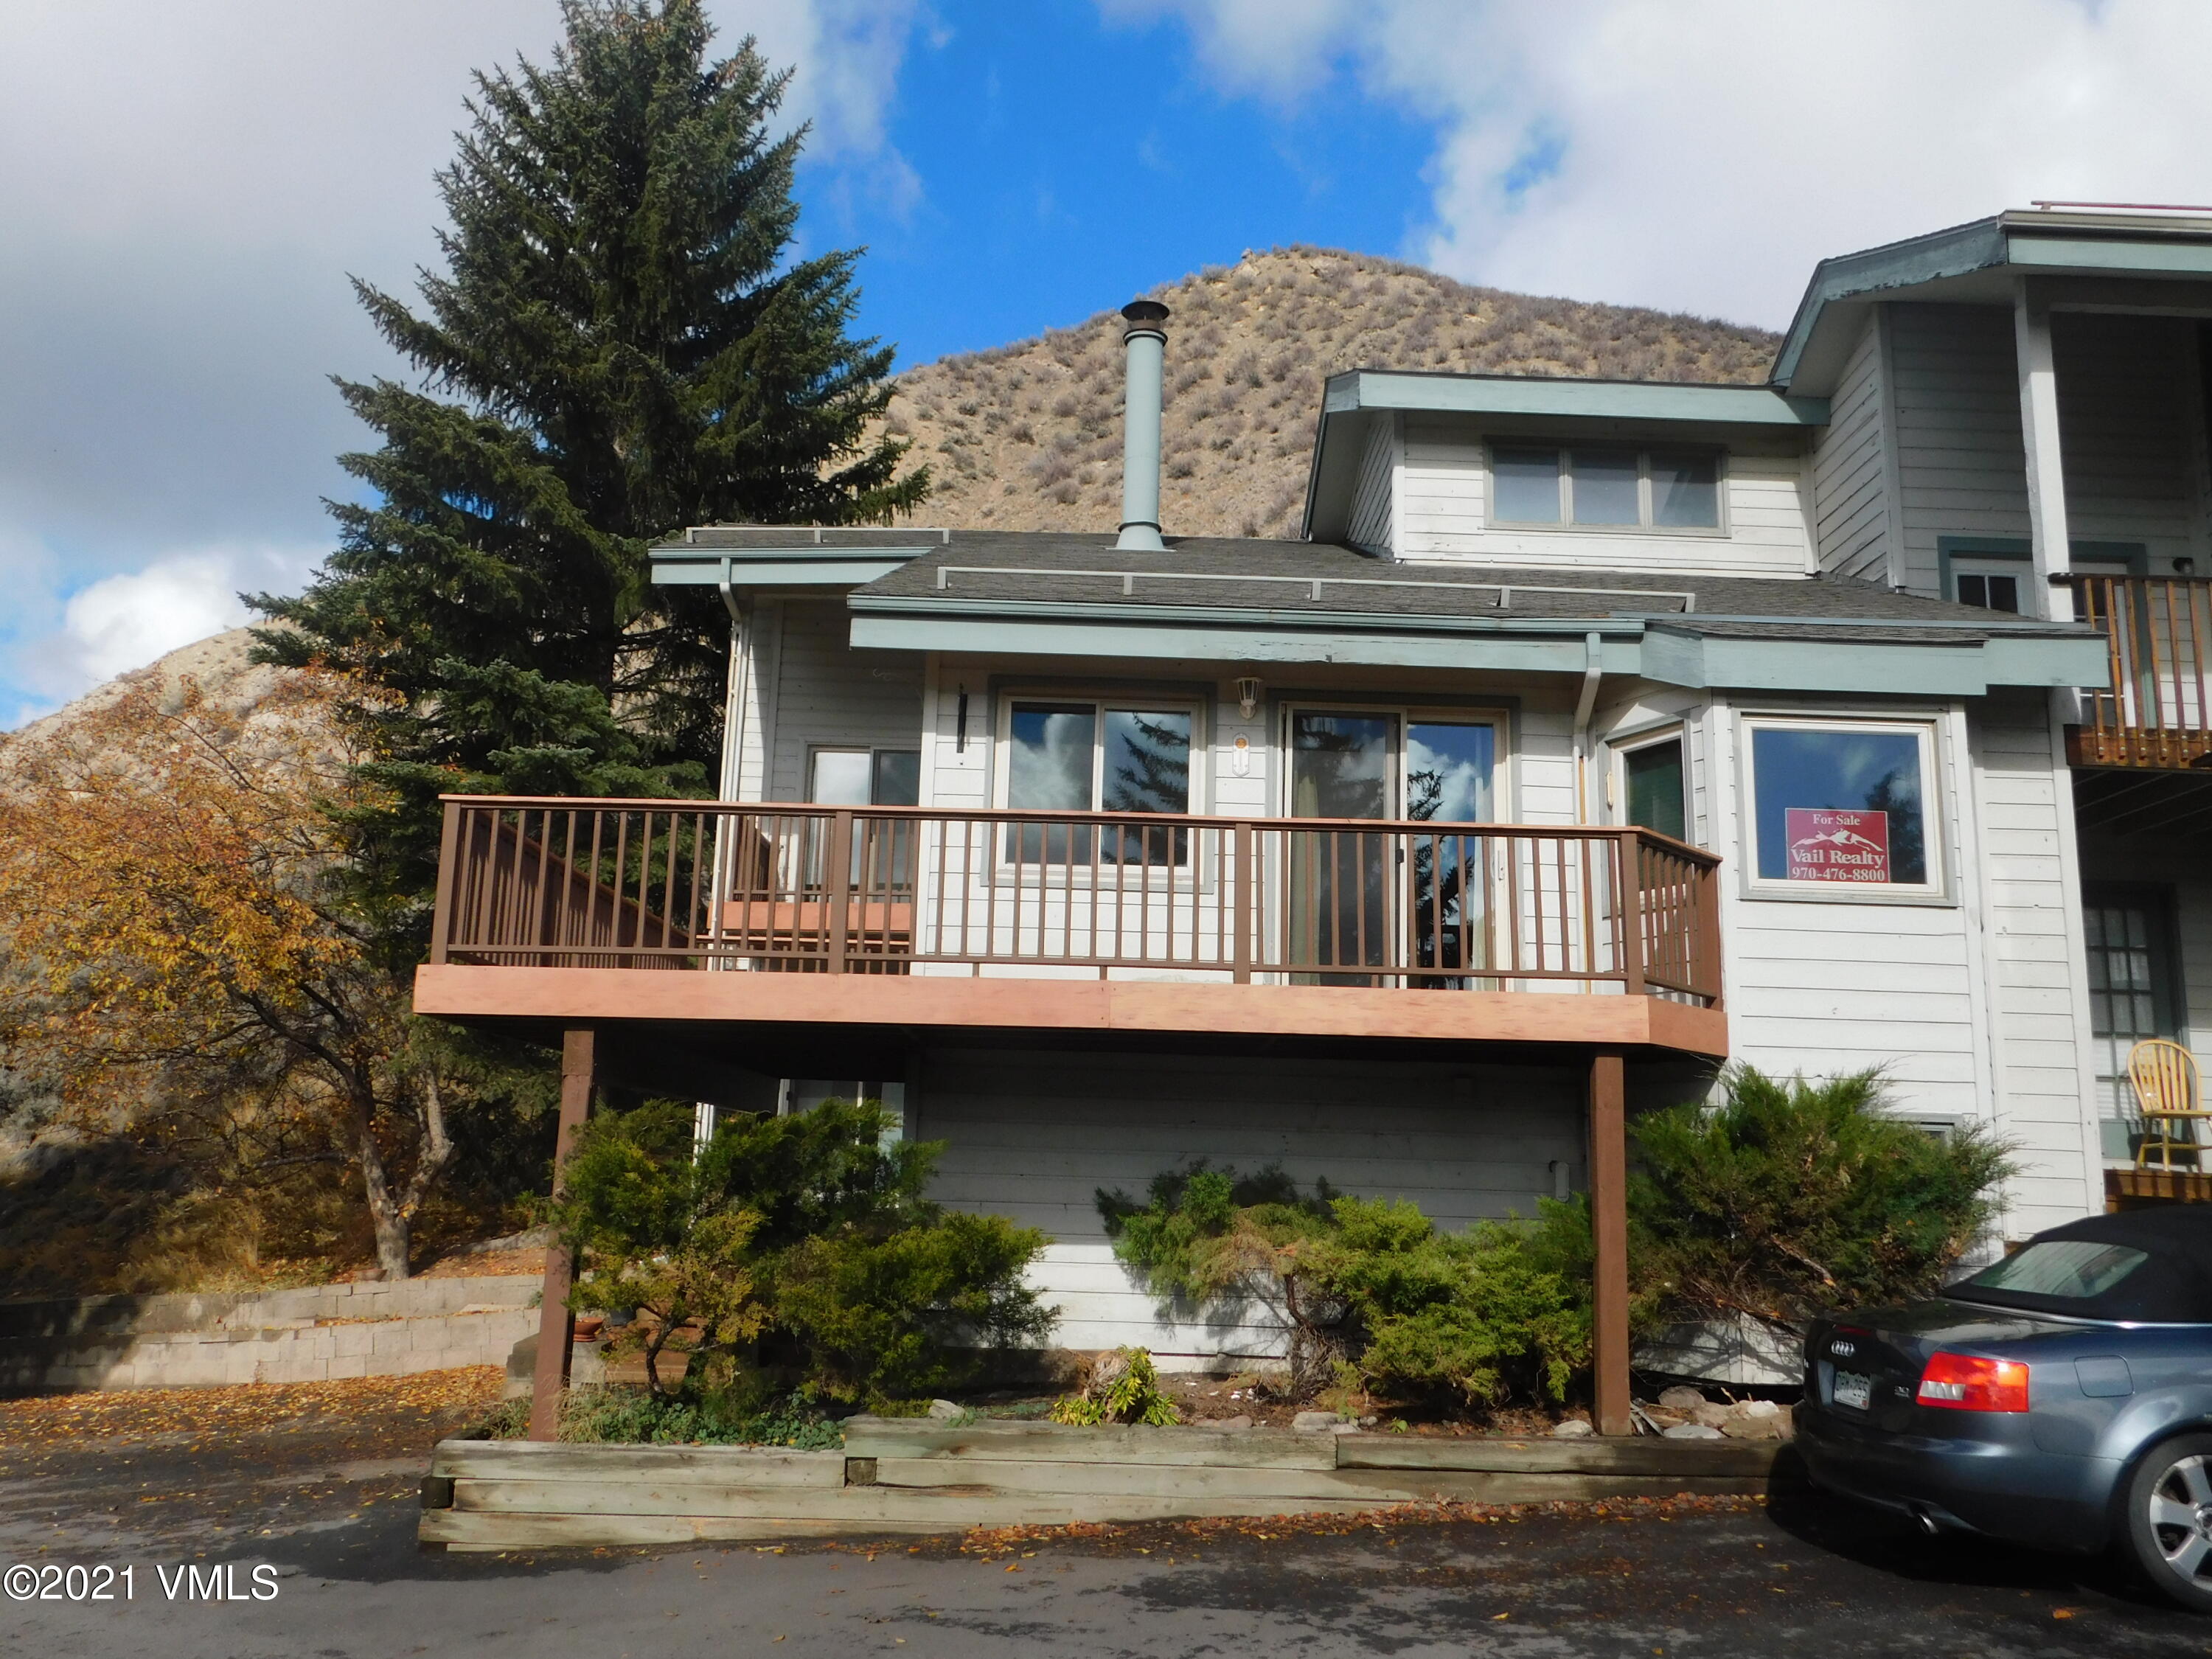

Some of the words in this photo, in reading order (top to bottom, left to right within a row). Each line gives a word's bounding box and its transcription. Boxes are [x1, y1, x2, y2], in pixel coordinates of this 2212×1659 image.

[1812, 813, 1833, 824] For
[1836, 815, 1861, 826] Sale
[1790, 849, 1825, 863] Vail
[1829, 849, 1885, 869] Realty
[1792, 867, 1885, 881] 970-476-8800
